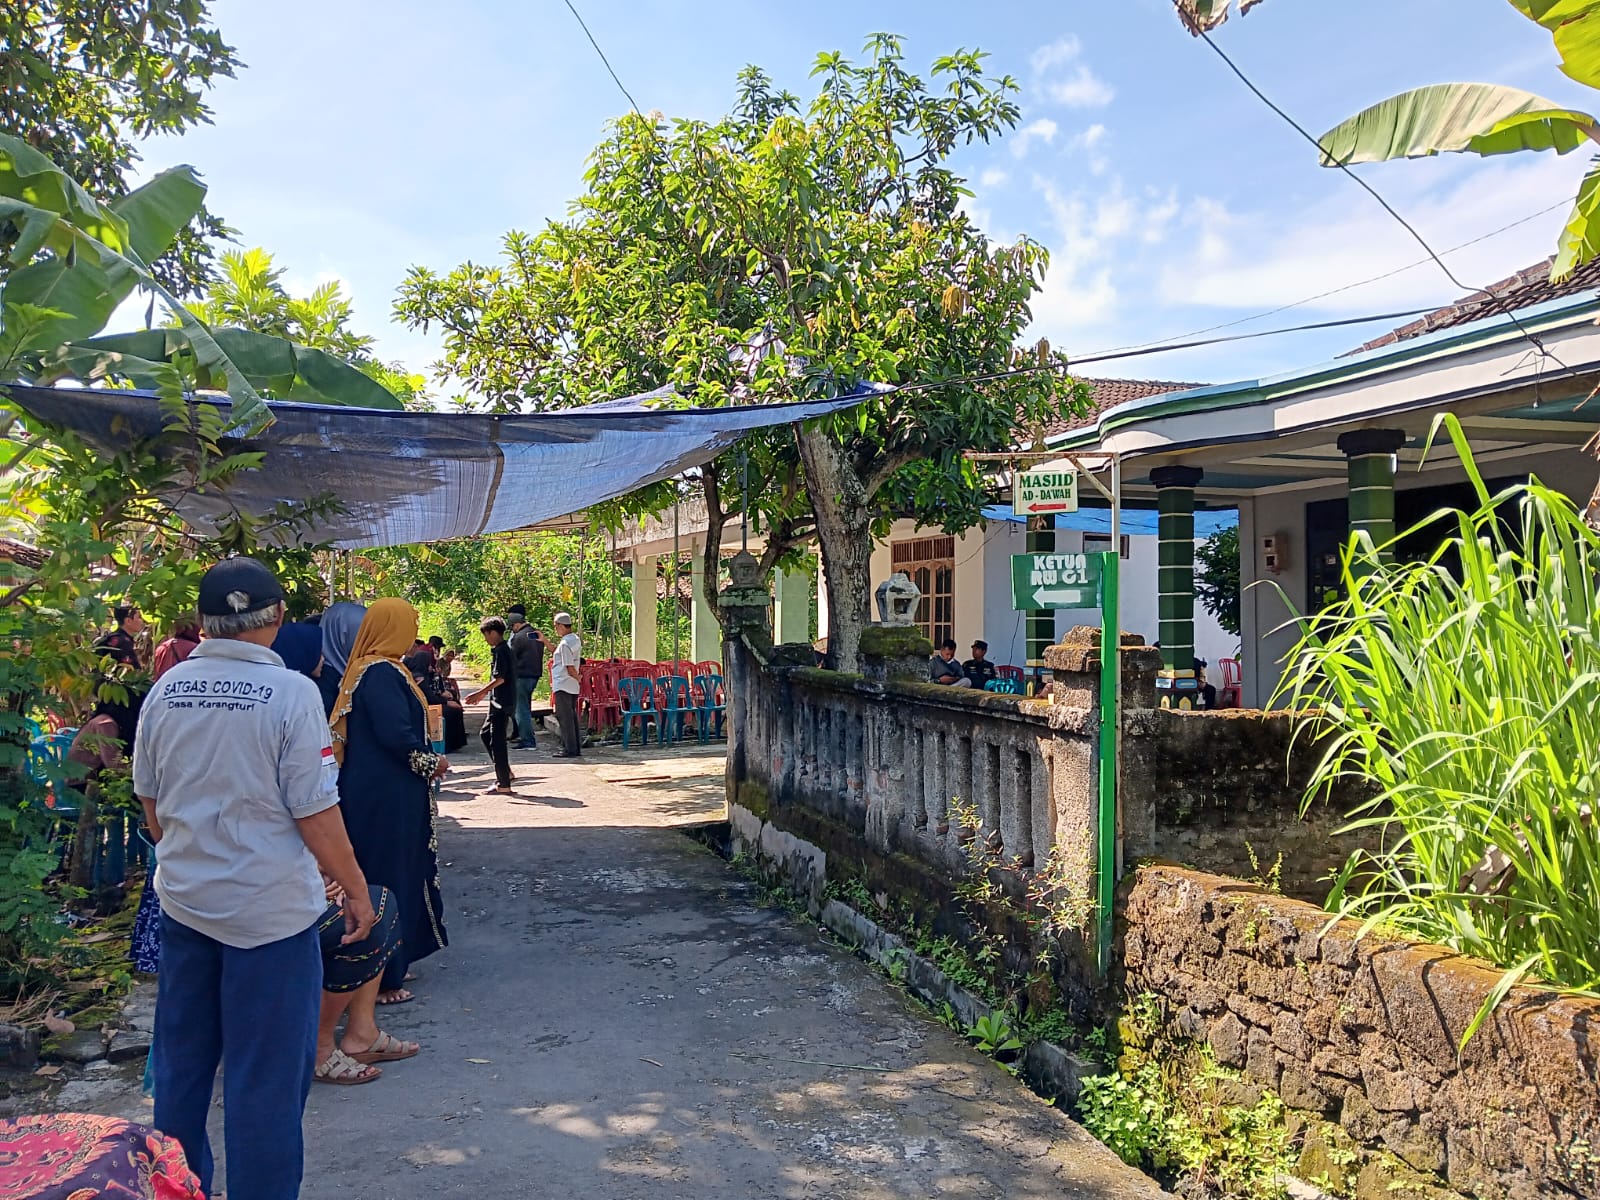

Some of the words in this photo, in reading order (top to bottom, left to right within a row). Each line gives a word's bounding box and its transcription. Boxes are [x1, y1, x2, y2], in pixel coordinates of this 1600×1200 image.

[1019, 474, 1074, 488] MASJID
[1022, 490, 1034, 501] AD
[1033, 554, 1087, 570] KETUA
[1031, 570, 1058, 586] RW
[164, 680, 208, 696] SATGAS
[212, 680, 273, 700] COVID-19
[168, 701, 193, 709] Desa
[198, 699, 256, 711] Karangturi
